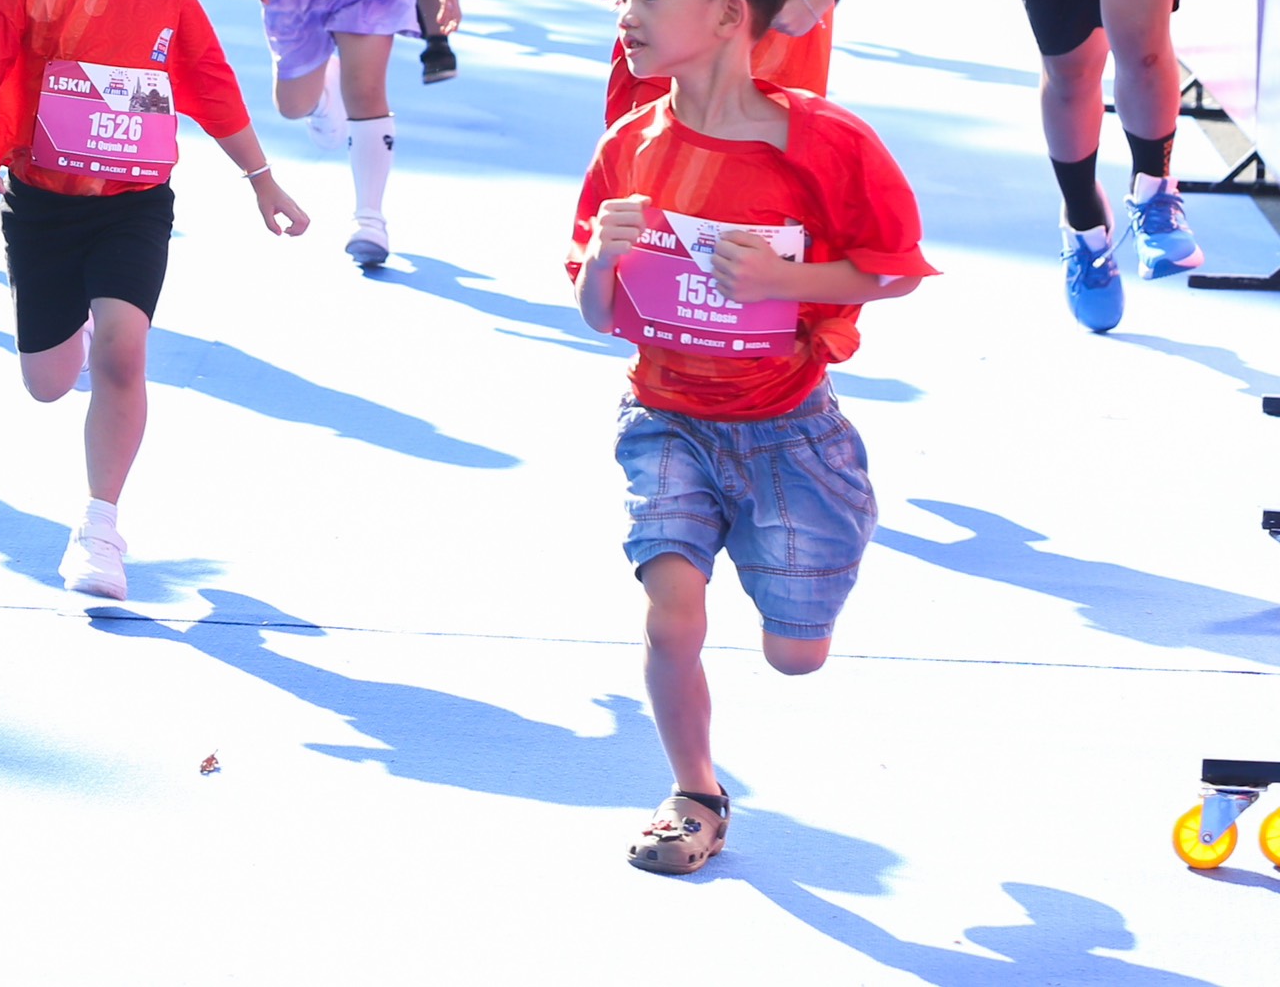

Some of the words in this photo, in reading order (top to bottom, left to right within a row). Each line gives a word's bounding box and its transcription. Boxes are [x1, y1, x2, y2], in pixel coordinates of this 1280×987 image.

[48, 76, 91, 94] 1,5KM
[89, 112, 143, 141] 1526
[123, 143, 138, 154] Anh
[70, 160, 84, 168] SIZE
[101, 166, 127, 174] RACEKIT
[693, 337, 725, 348] RACEKIT
[745, 341, 771, 350] MEDAL
